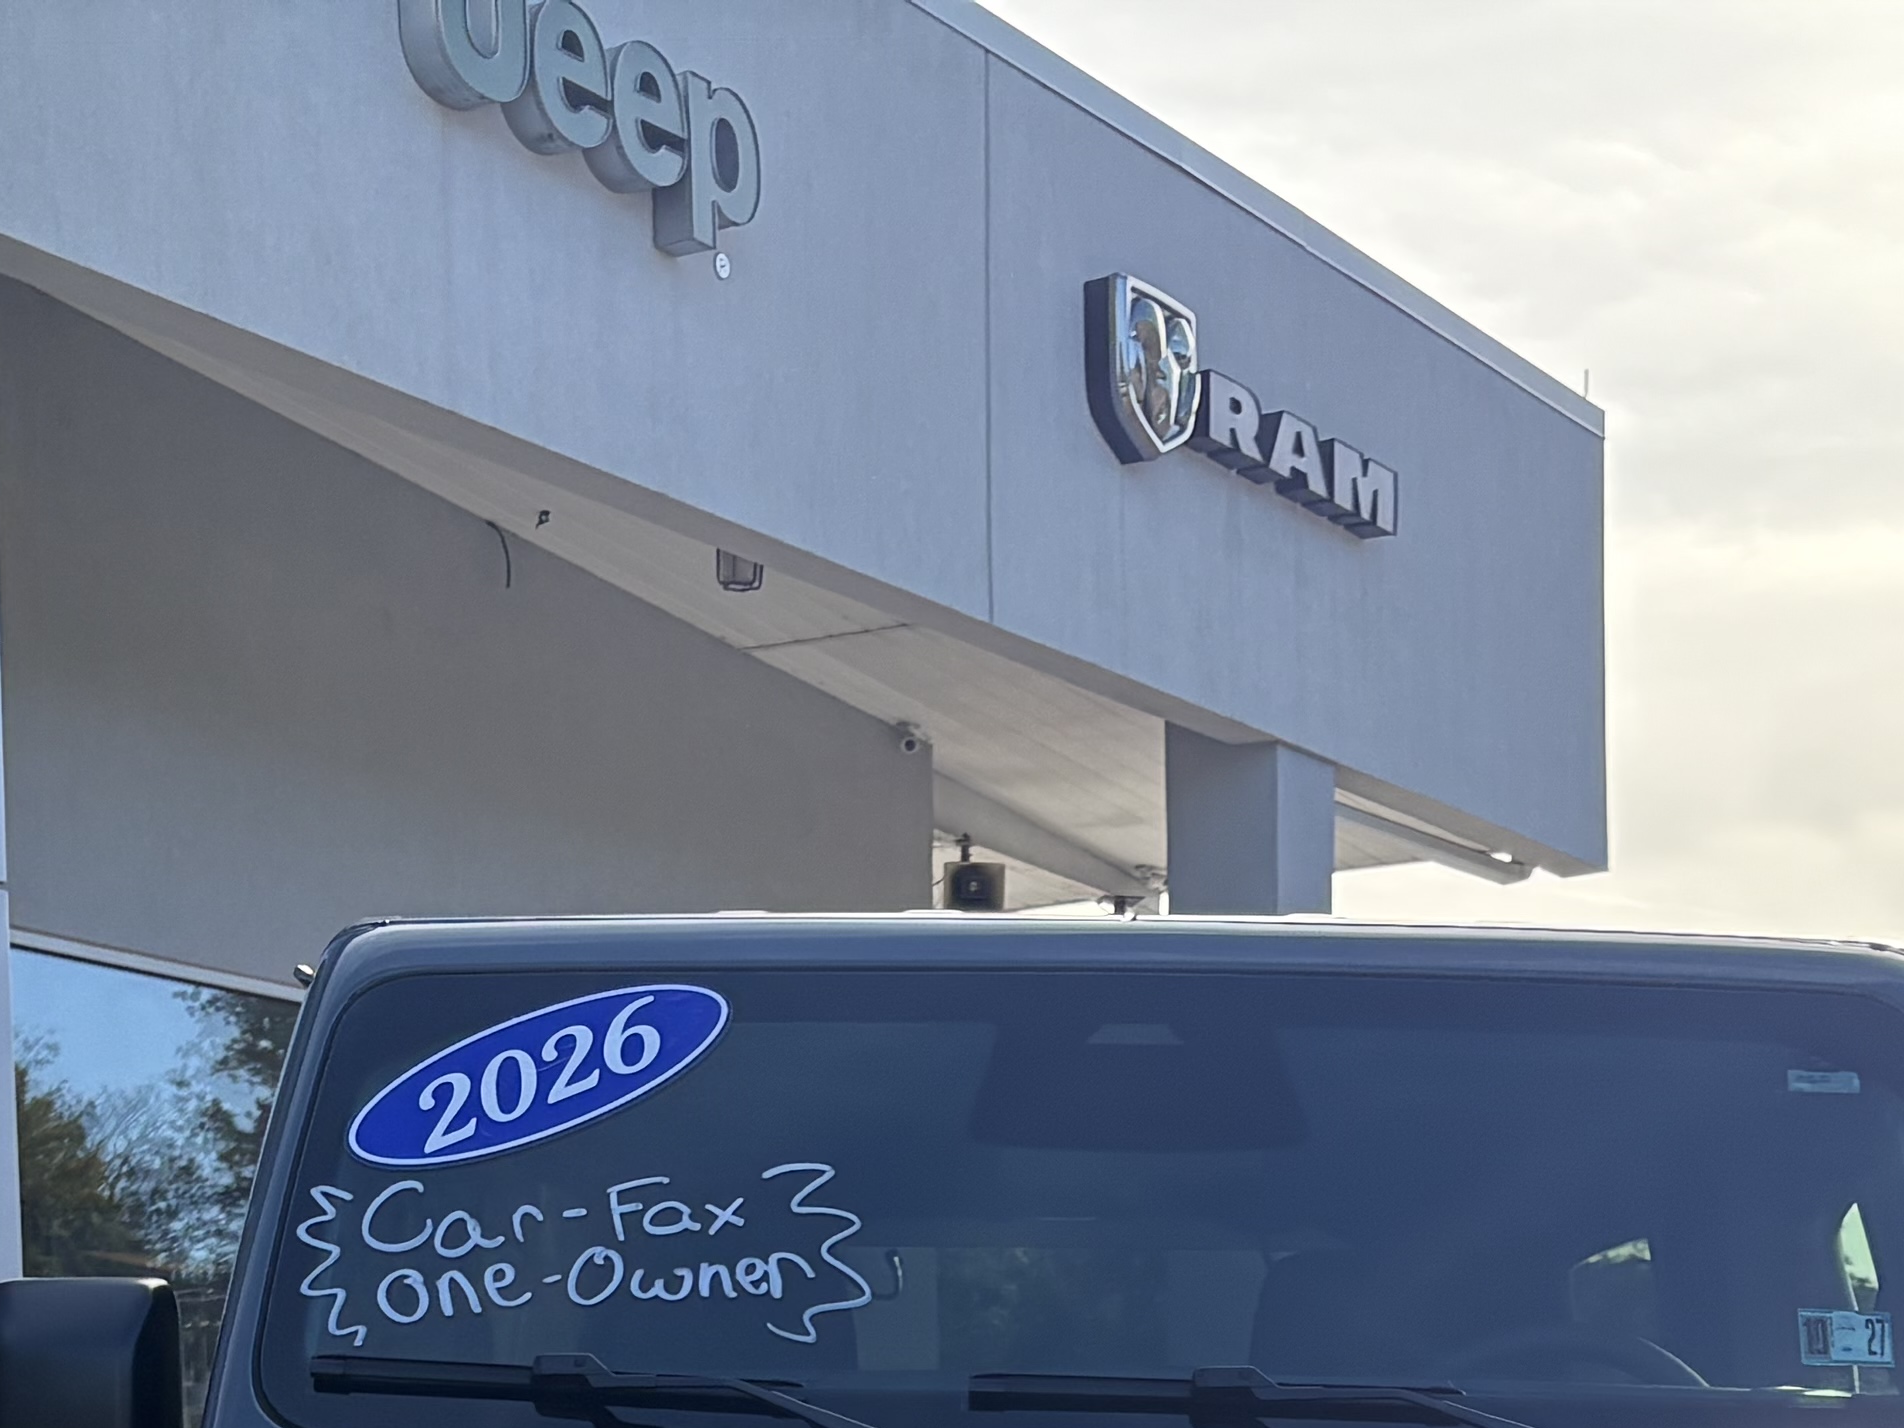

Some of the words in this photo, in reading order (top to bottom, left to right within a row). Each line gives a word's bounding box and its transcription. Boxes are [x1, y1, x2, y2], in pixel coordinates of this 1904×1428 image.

[1198, 368, 1398, 539] RAM
[418, 994, 662, 1155] 2026
[361, 1175, 746, 1259] Car-Fax
[1864, 1317, 1886, 1357] 27
